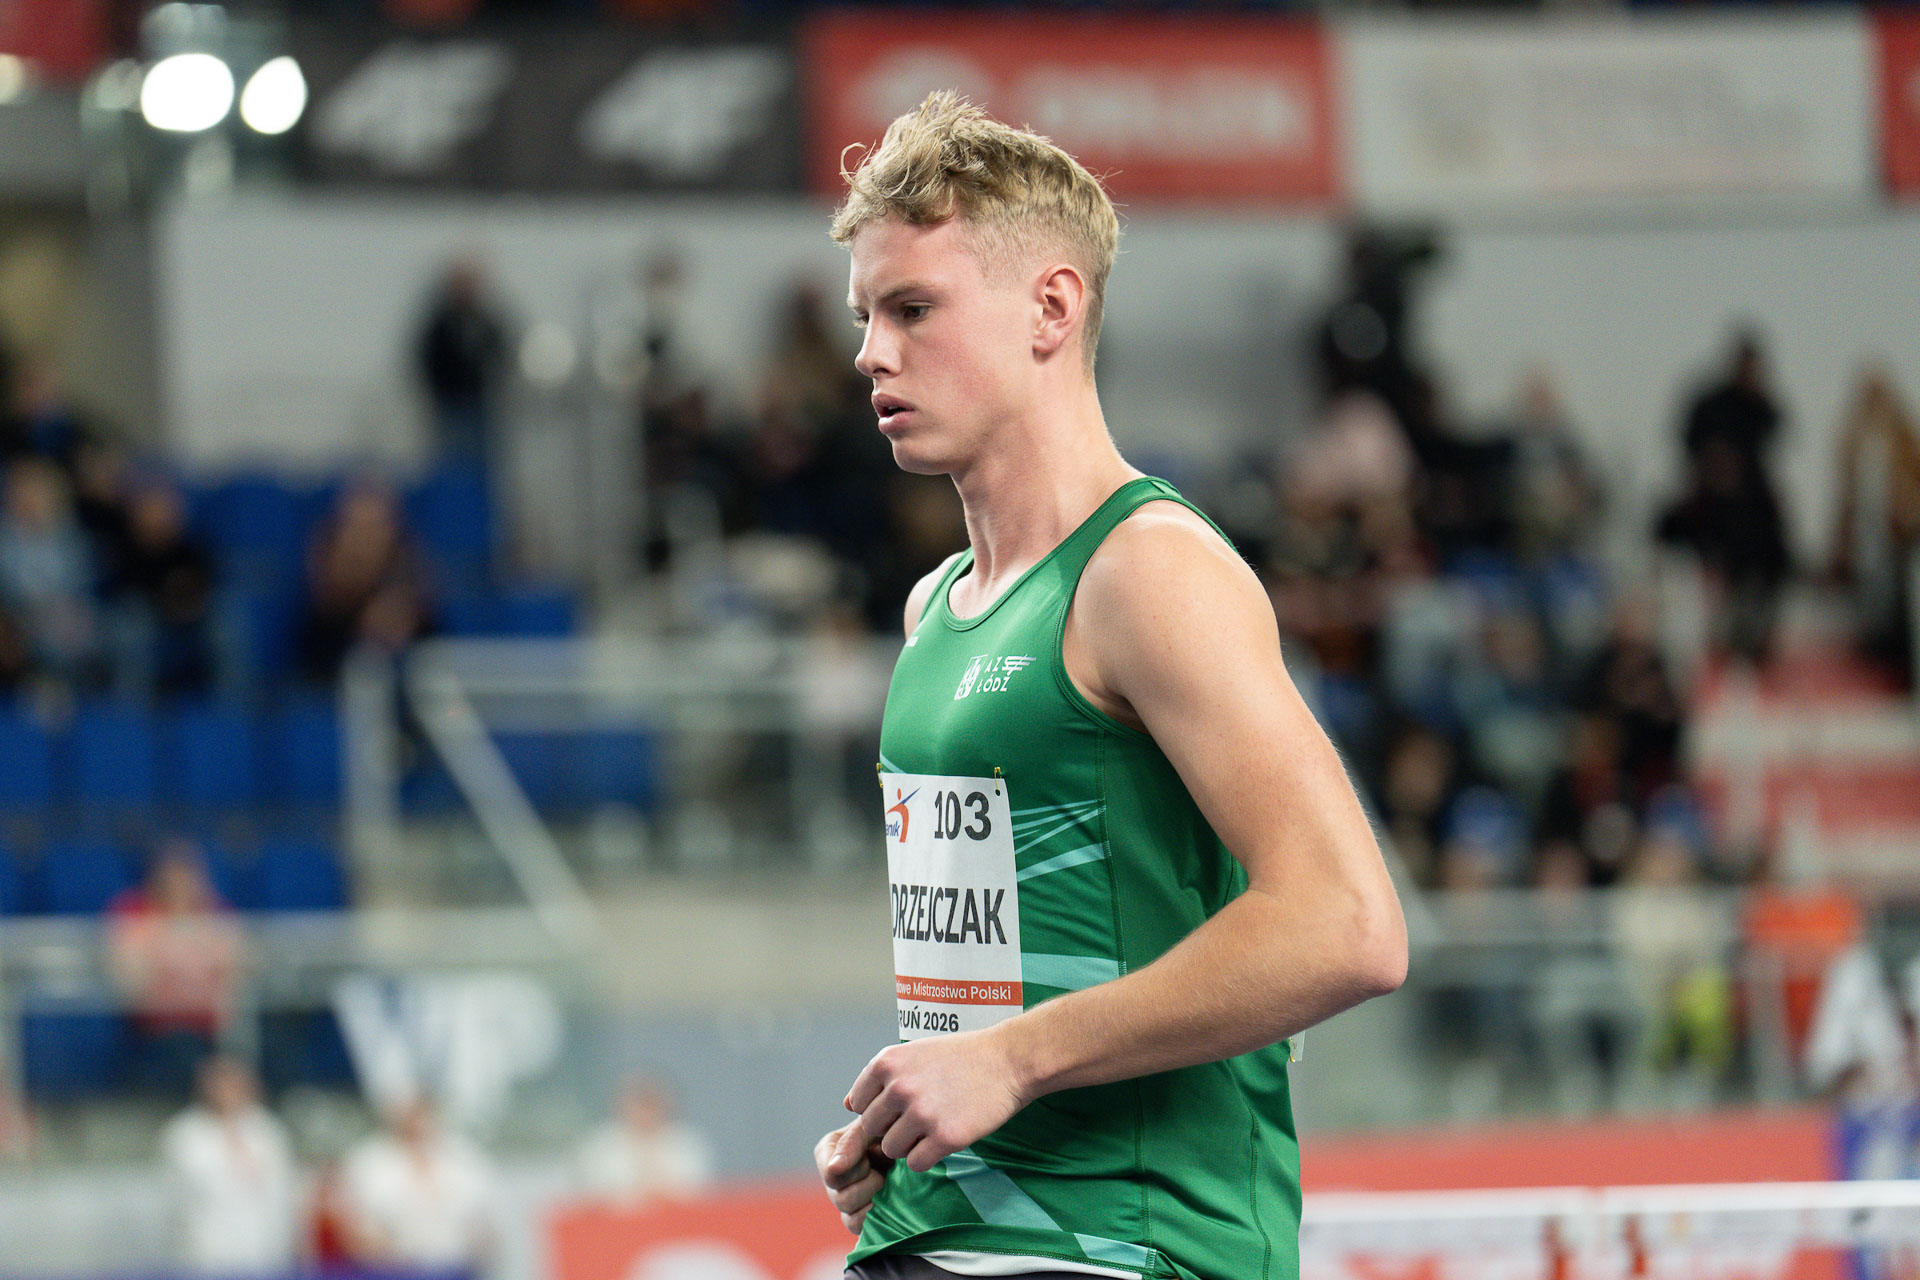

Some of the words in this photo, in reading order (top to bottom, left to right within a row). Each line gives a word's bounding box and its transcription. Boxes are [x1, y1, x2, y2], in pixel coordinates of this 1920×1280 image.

[934, 790, 992, 841] 103
[913, 982, 968, 999] Mistrzostwa
[970, 986, 1012, 1000] Polski
[923, 1011, 959, 1033] 2026
